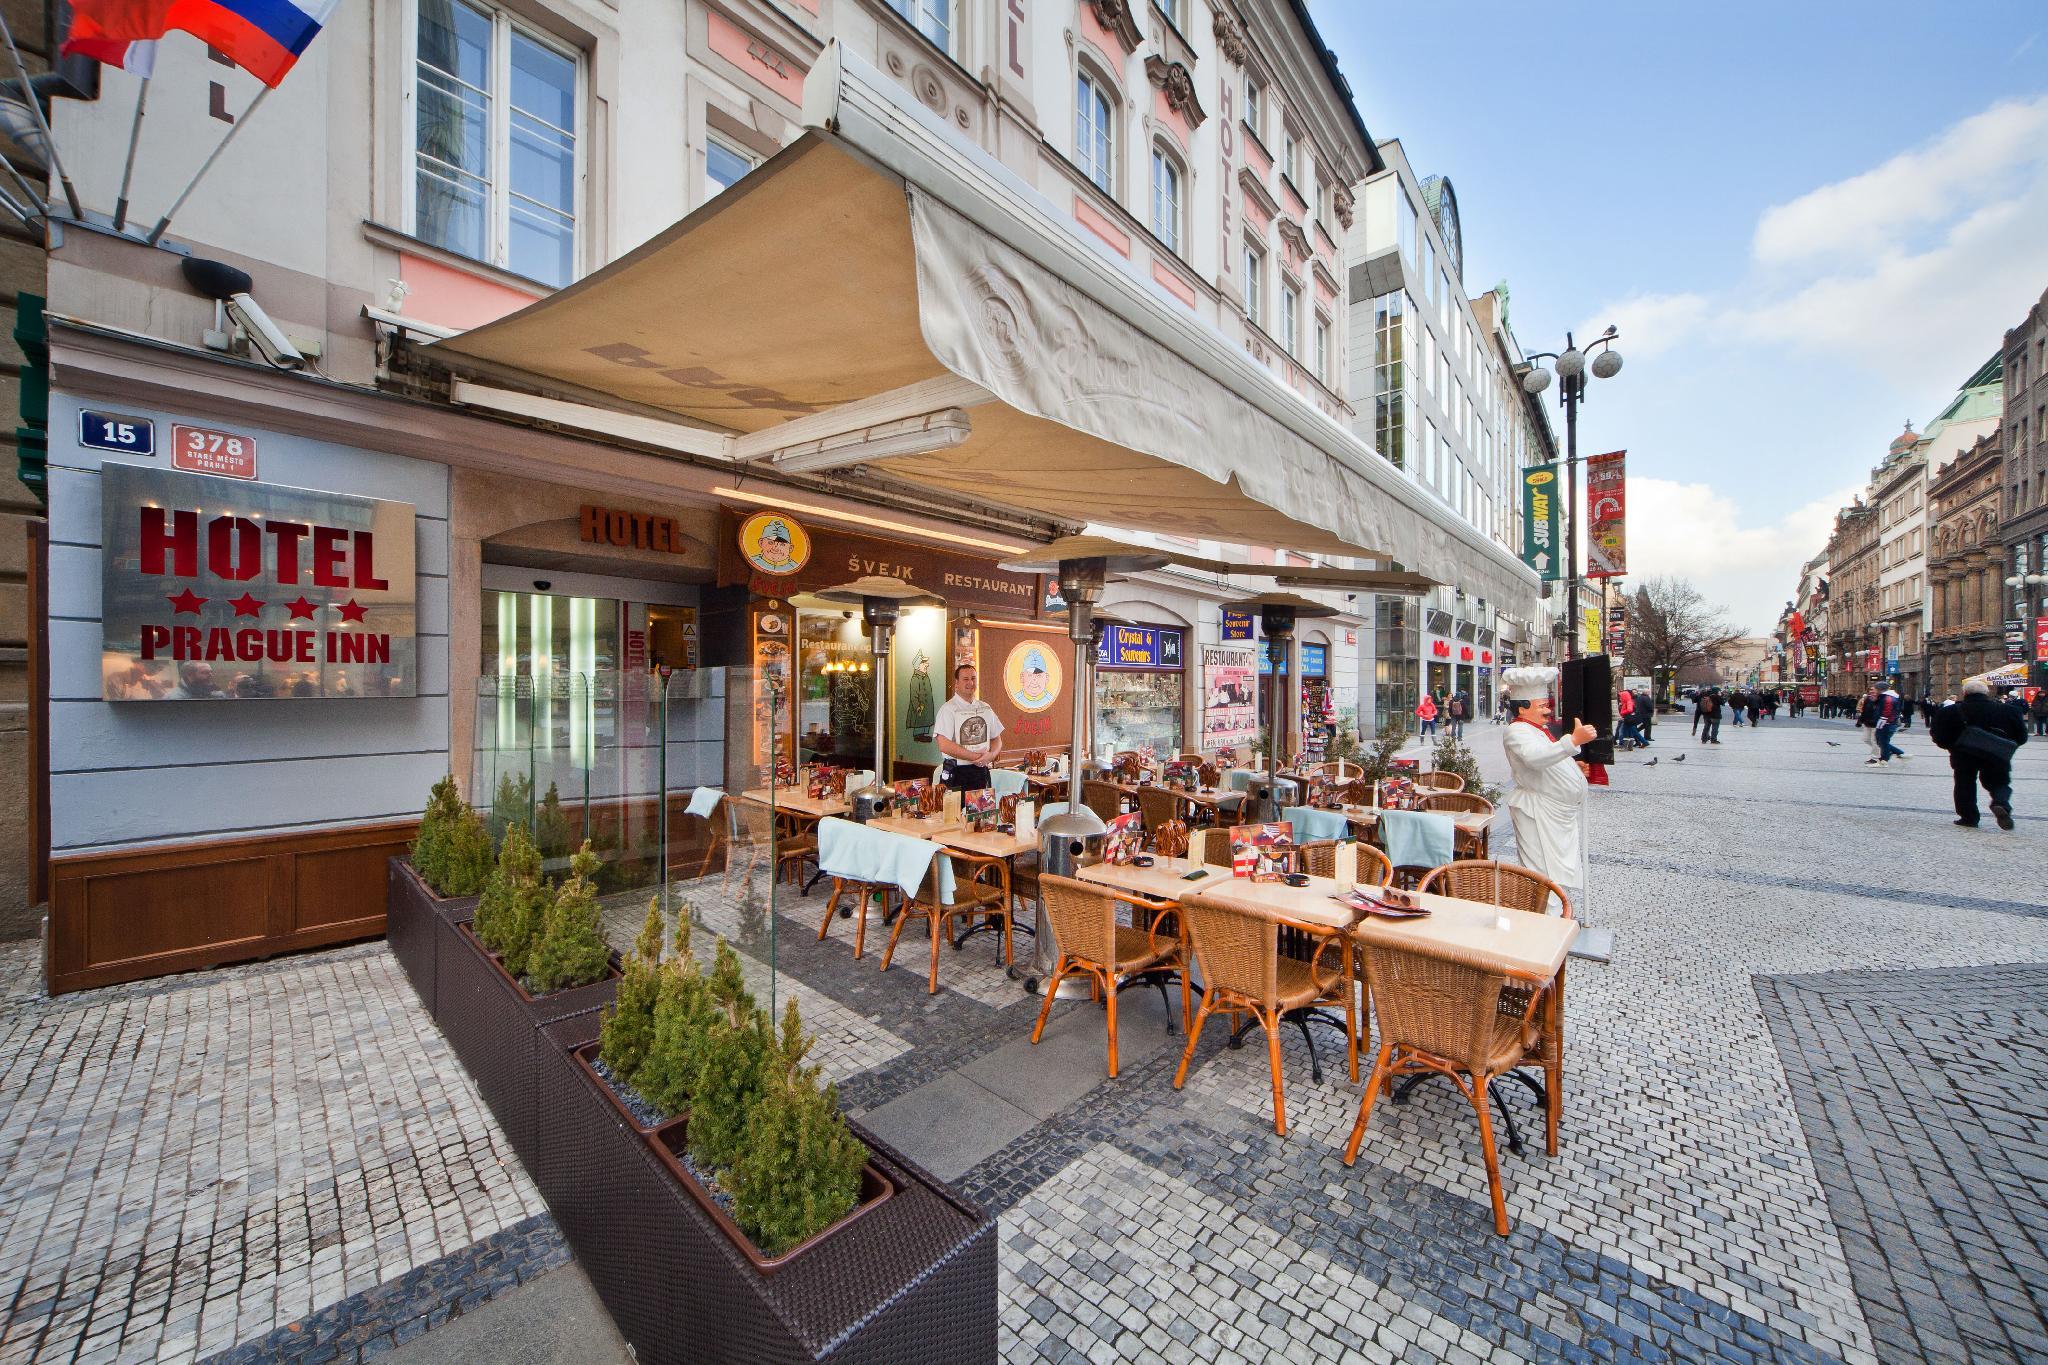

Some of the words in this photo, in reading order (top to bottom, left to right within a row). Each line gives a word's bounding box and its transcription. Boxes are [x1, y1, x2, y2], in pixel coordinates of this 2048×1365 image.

[1220, 77, 1233, 275] HOTEL
[103, 421, 136, 444] 15
[188, 431, 243, 456] 378
[580, 504, 687, 555] HOTEL
[1532, 487, 1550, 549] SUBWAY
[140, 506, 389, 591] HOTEL
[848, 553, 915, 581] ŠVEJK
[944, 572, 1035, 597] RESTAURANT
[140, 624, 316, 663] PRAGUE
[326, 632, 390, 664] INN
[629, 630, 644, 667] HOTEL
[1119, 628, 1143, 647] Crystal
[1120, 646, 1151, 663] Souvenirs
[1205, 649, 1247, 667] RESTAURANT
